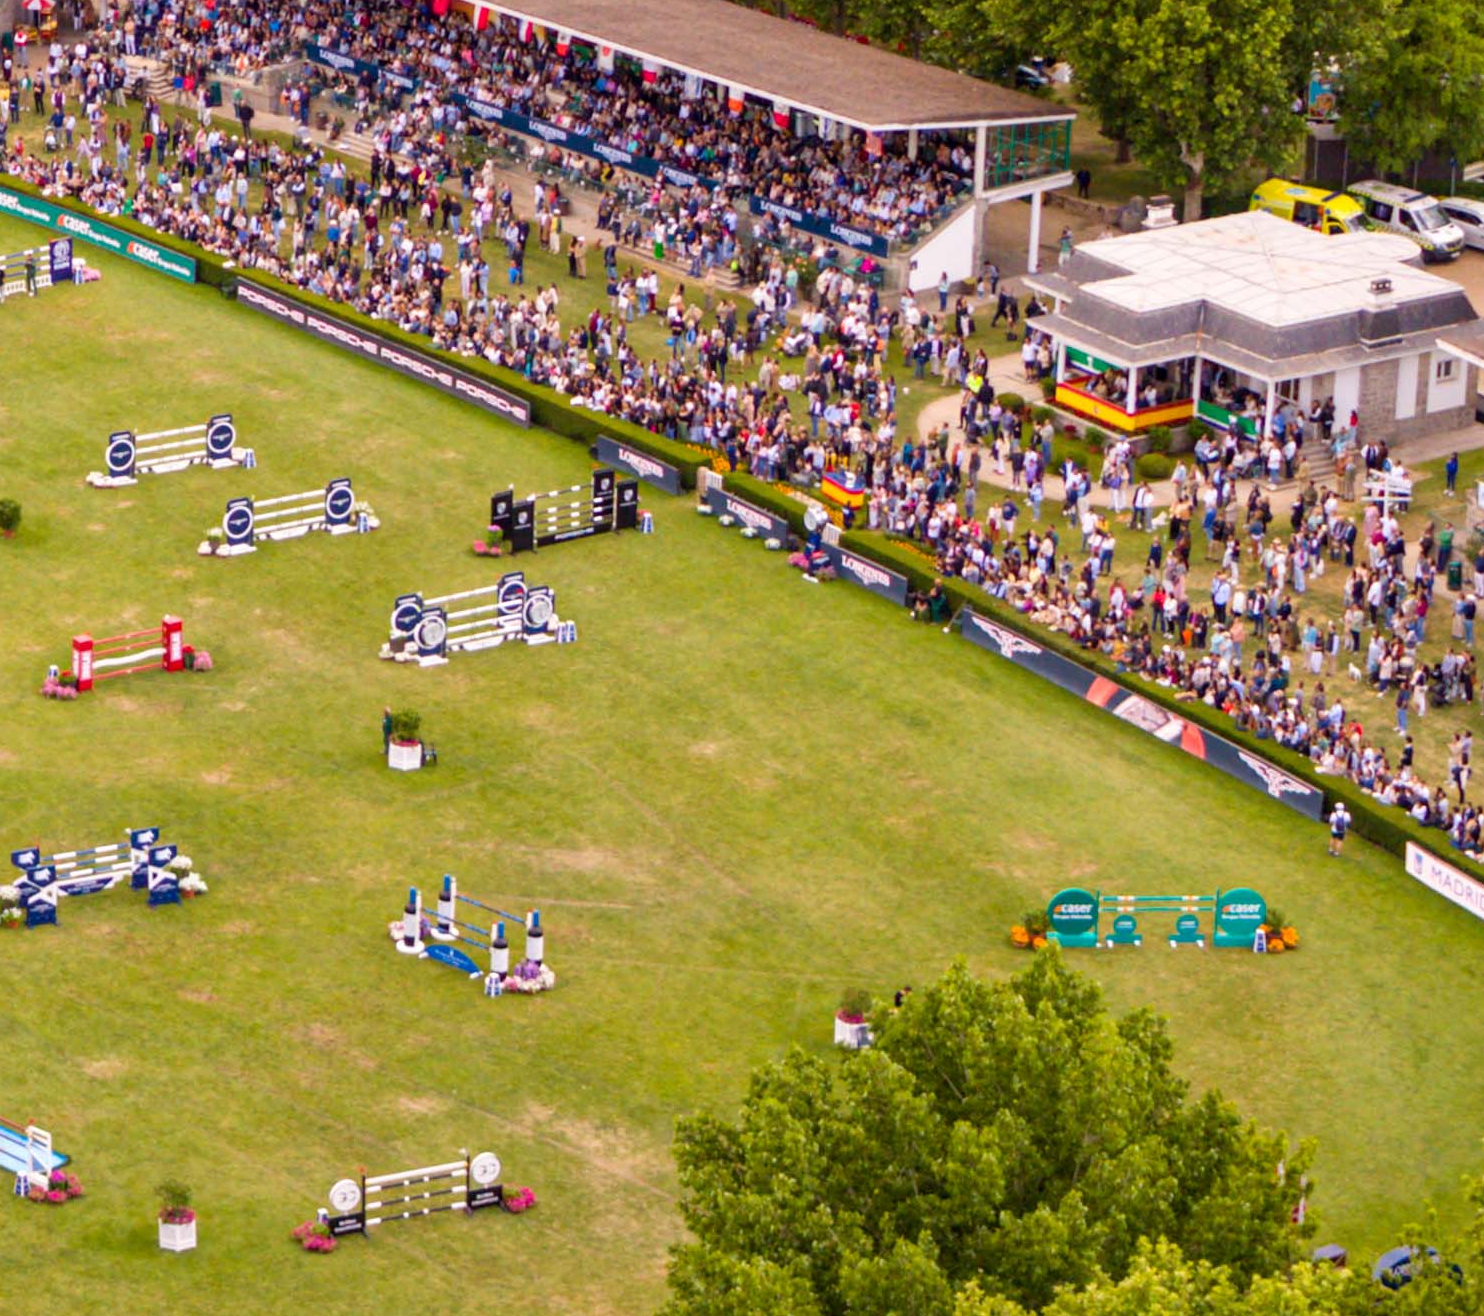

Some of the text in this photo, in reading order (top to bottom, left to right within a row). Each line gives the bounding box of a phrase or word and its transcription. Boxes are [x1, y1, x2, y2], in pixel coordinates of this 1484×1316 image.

[238, 285, 526, 421] PORSCHE PORSCHE PORSCHE PORSCHE
